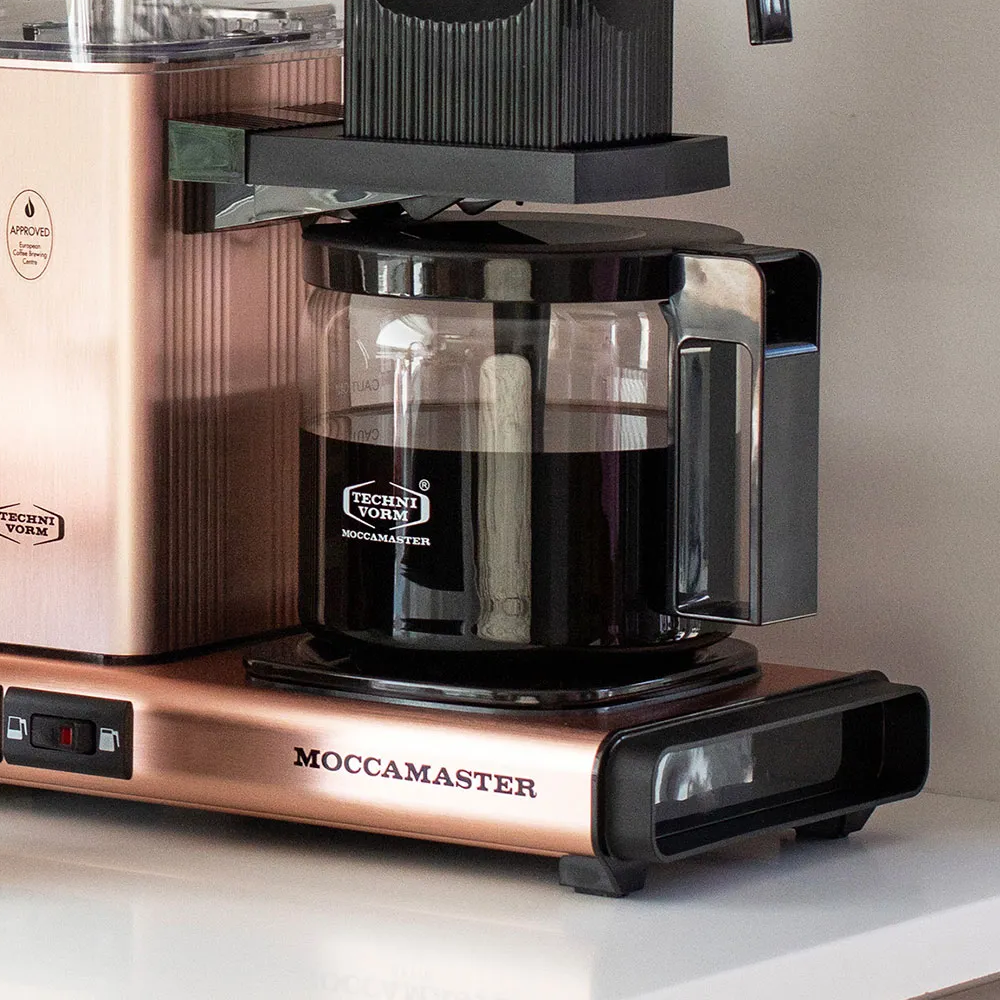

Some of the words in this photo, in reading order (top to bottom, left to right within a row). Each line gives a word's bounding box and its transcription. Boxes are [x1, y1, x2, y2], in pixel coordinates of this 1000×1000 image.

[10, 226, 50, 237] APPROVED
[19, 241, 40, 249] European
[29, 251, 47, 259] Brewing
[351, 491, 418, 509] TECHNI
[357, 505, 409, 522] VORM
[5, 523, 49, 537] VORM
[341, 528, 431, 546] MOCCAMASTER
[293, 746, 538, 799] MOCCAMASTER
